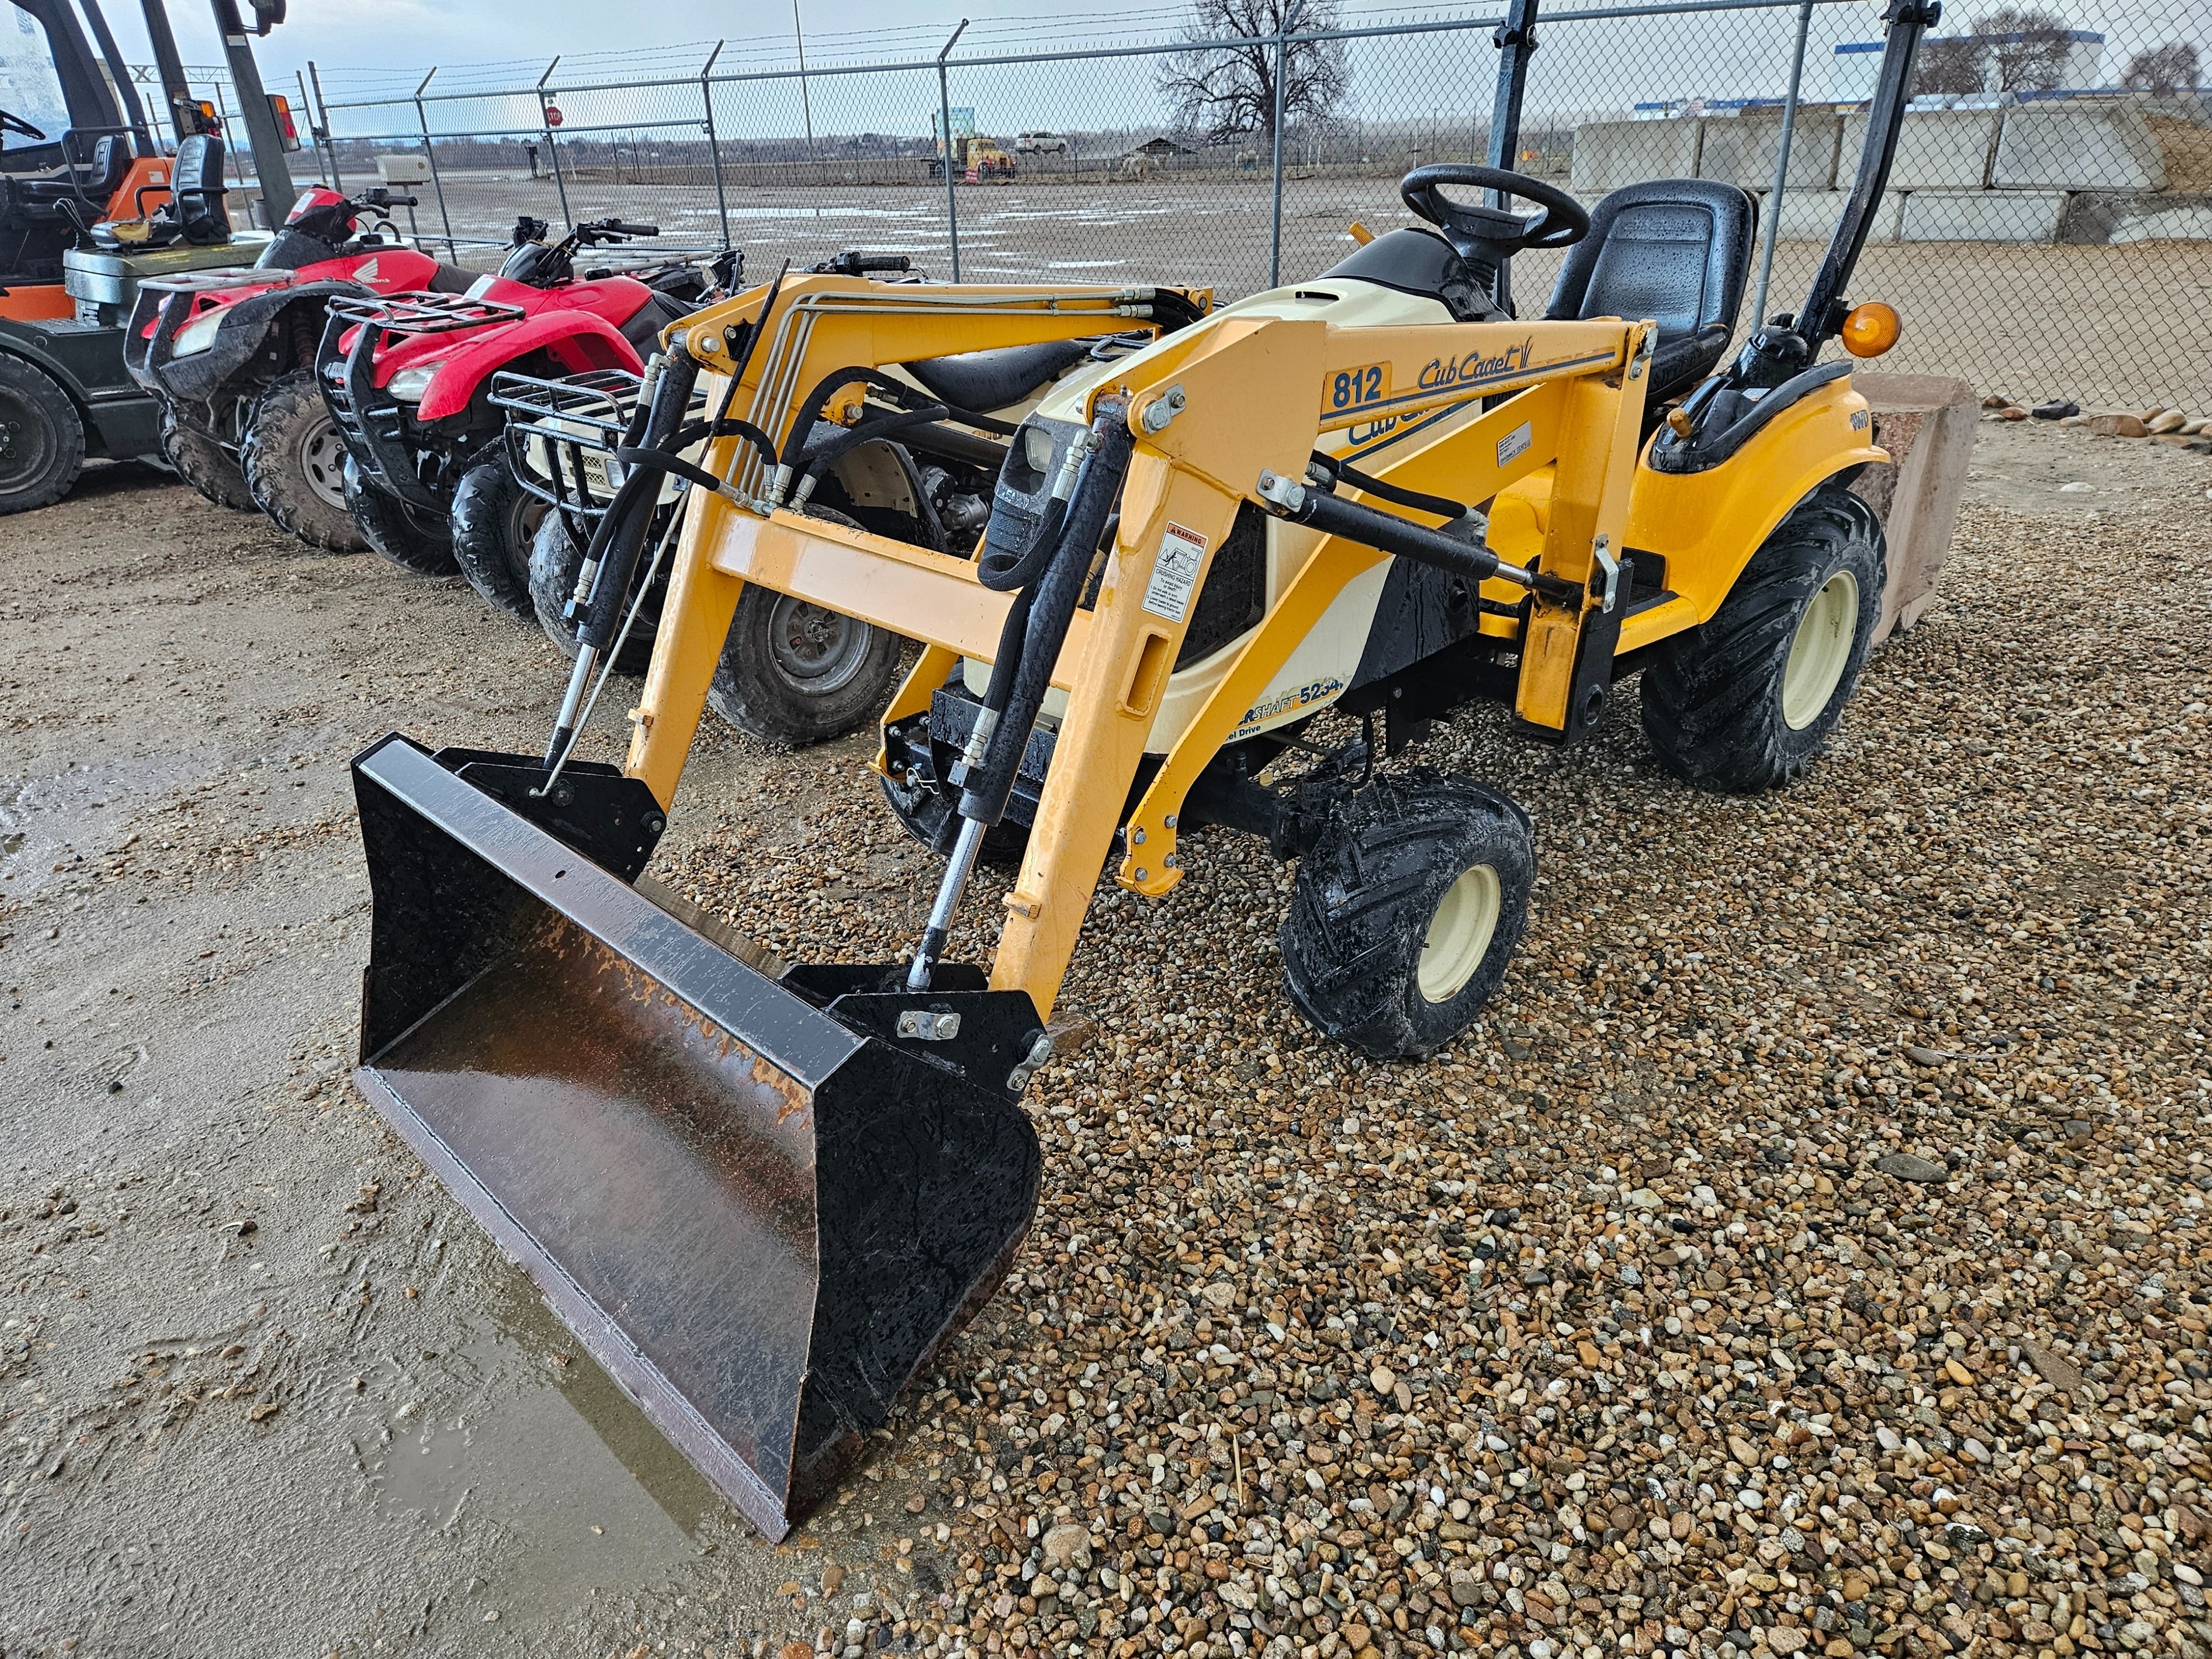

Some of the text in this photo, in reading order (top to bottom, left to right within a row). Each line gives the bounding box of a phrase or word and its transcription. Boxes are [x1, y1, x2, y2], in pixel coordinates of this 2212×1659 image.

[1418, 347, 1521, 389] Cub Cadet
[1333, 366, 1382, 408] 812
[1176, 529, 1202, 545] WARNING
[1155, 568, 1191, 586] CRUSHING HAZARD
[1239, 726, 1261, 736] Drive
